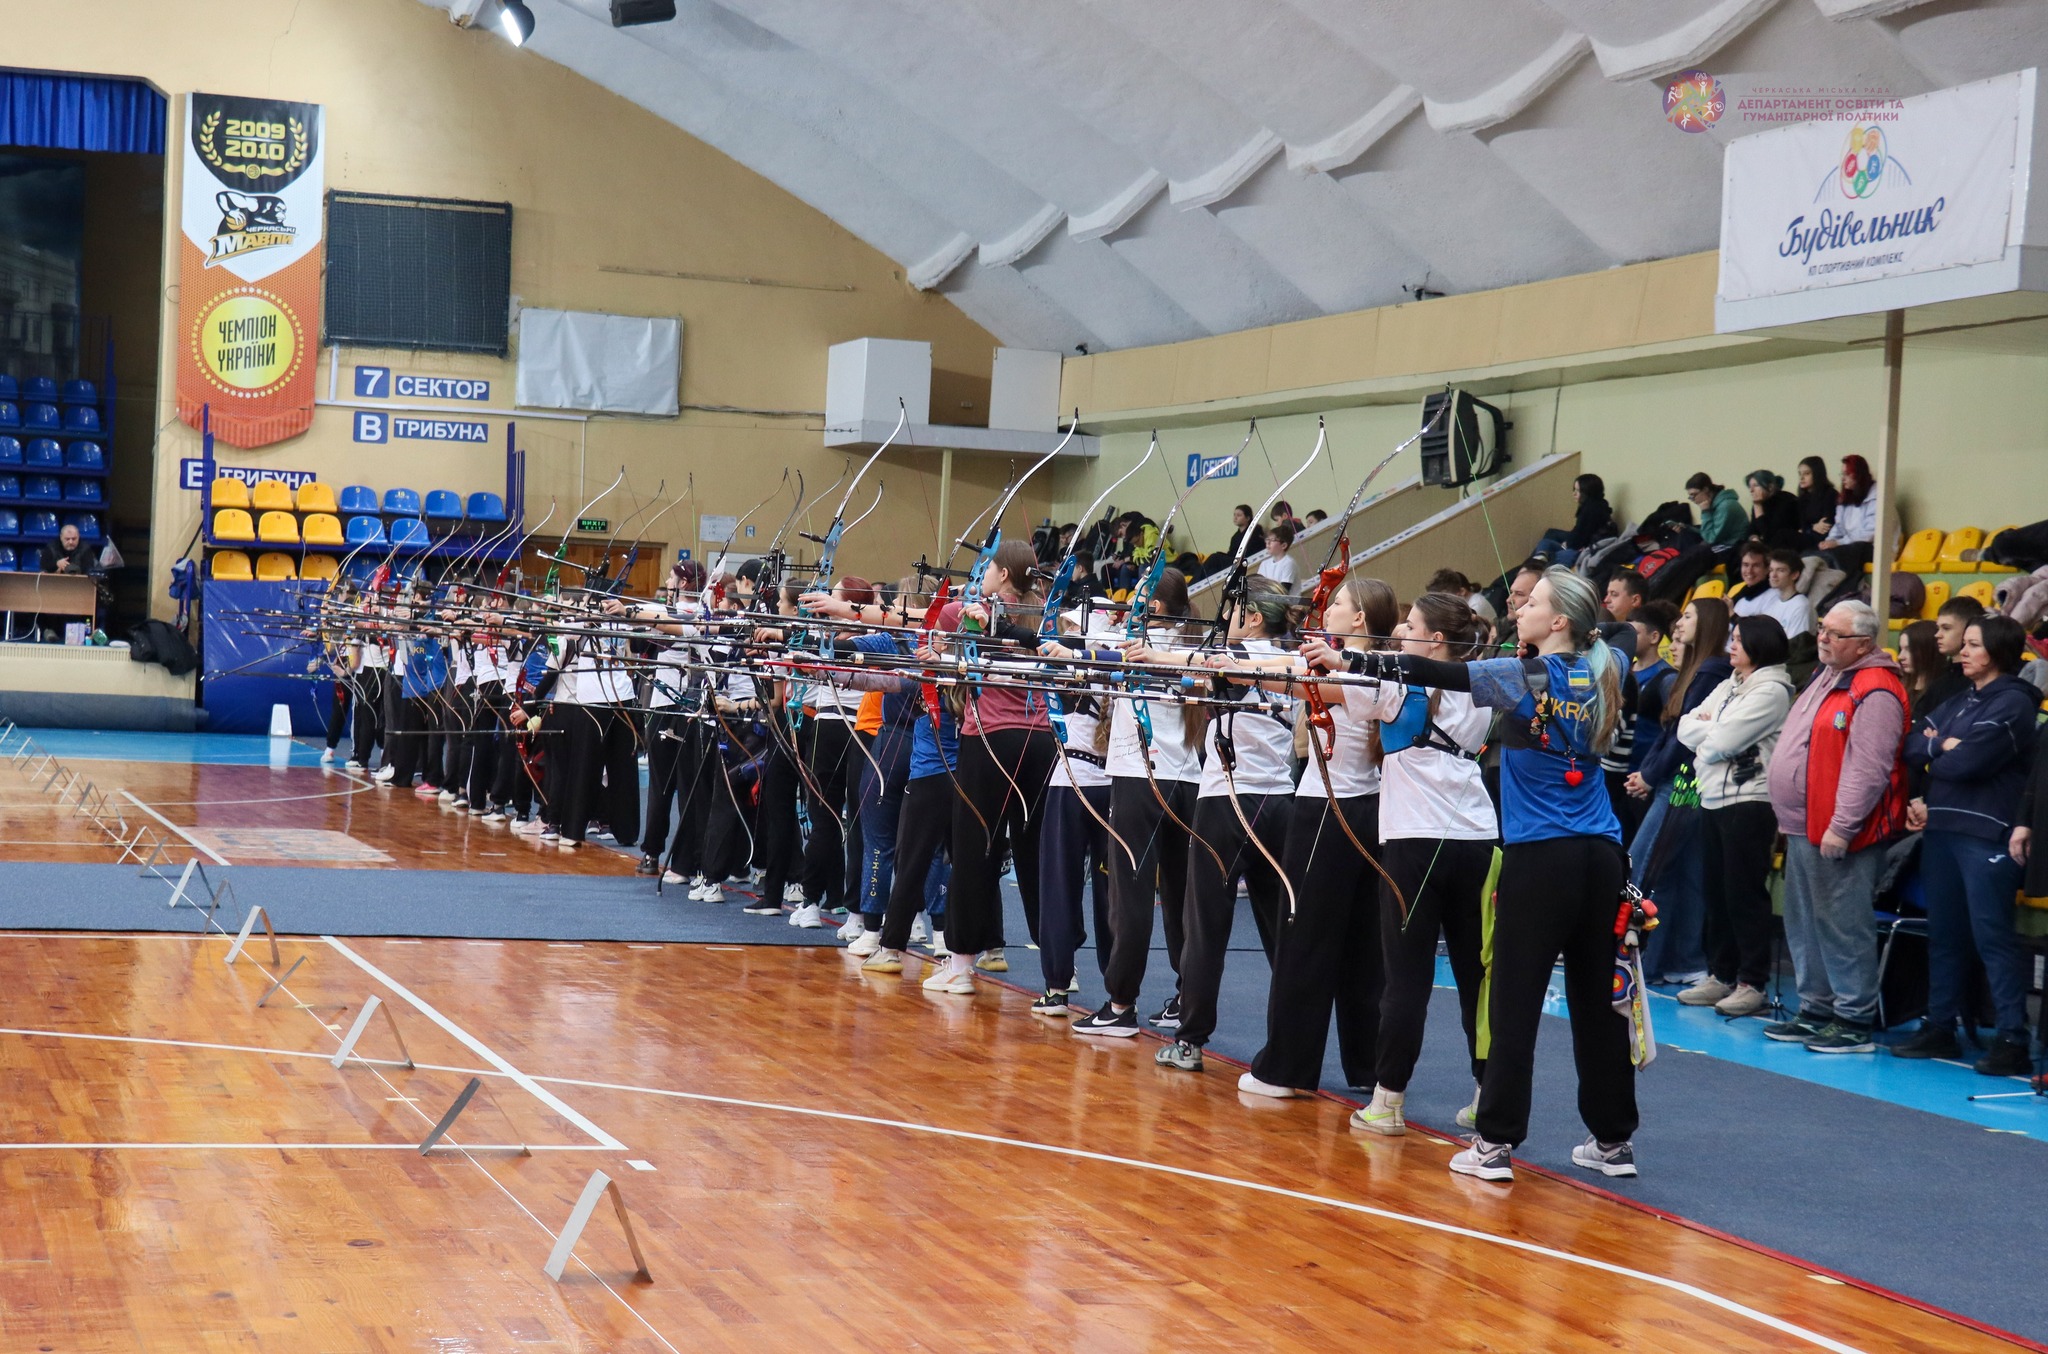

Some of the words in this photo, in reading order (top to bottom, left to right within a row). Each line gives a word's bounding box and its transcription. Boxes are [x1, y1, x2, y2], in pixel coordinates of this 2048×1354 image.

[225, 119, 286, 140] 2009
[225, 139, 285, 161] 2010
[246, 225, 296, 234] ЧЕРКАСЬКІ
[1779, 196, 1945, 265] Будівельник
[214, 232, 294, 258] МАВПИ
[1818, 256, 1865, 275] СПОРТИВНИЙ
[1865, 251, 1904, 267] КОМПЛЕКС
[219, 314, 277, 344] ЧЕМПІОН
[217, 341, 276, 372] УКРАЇНИ
[363, 369, 383, 395] 7
[398, 377, 487, 399] СЕКТОР
[360, 414, 382, 441] В
[395, 420, 487, 441] ТРИБУНА
[1190, 458, 1198, 481] 4
[1550, 697, 1592, 722] KRA
